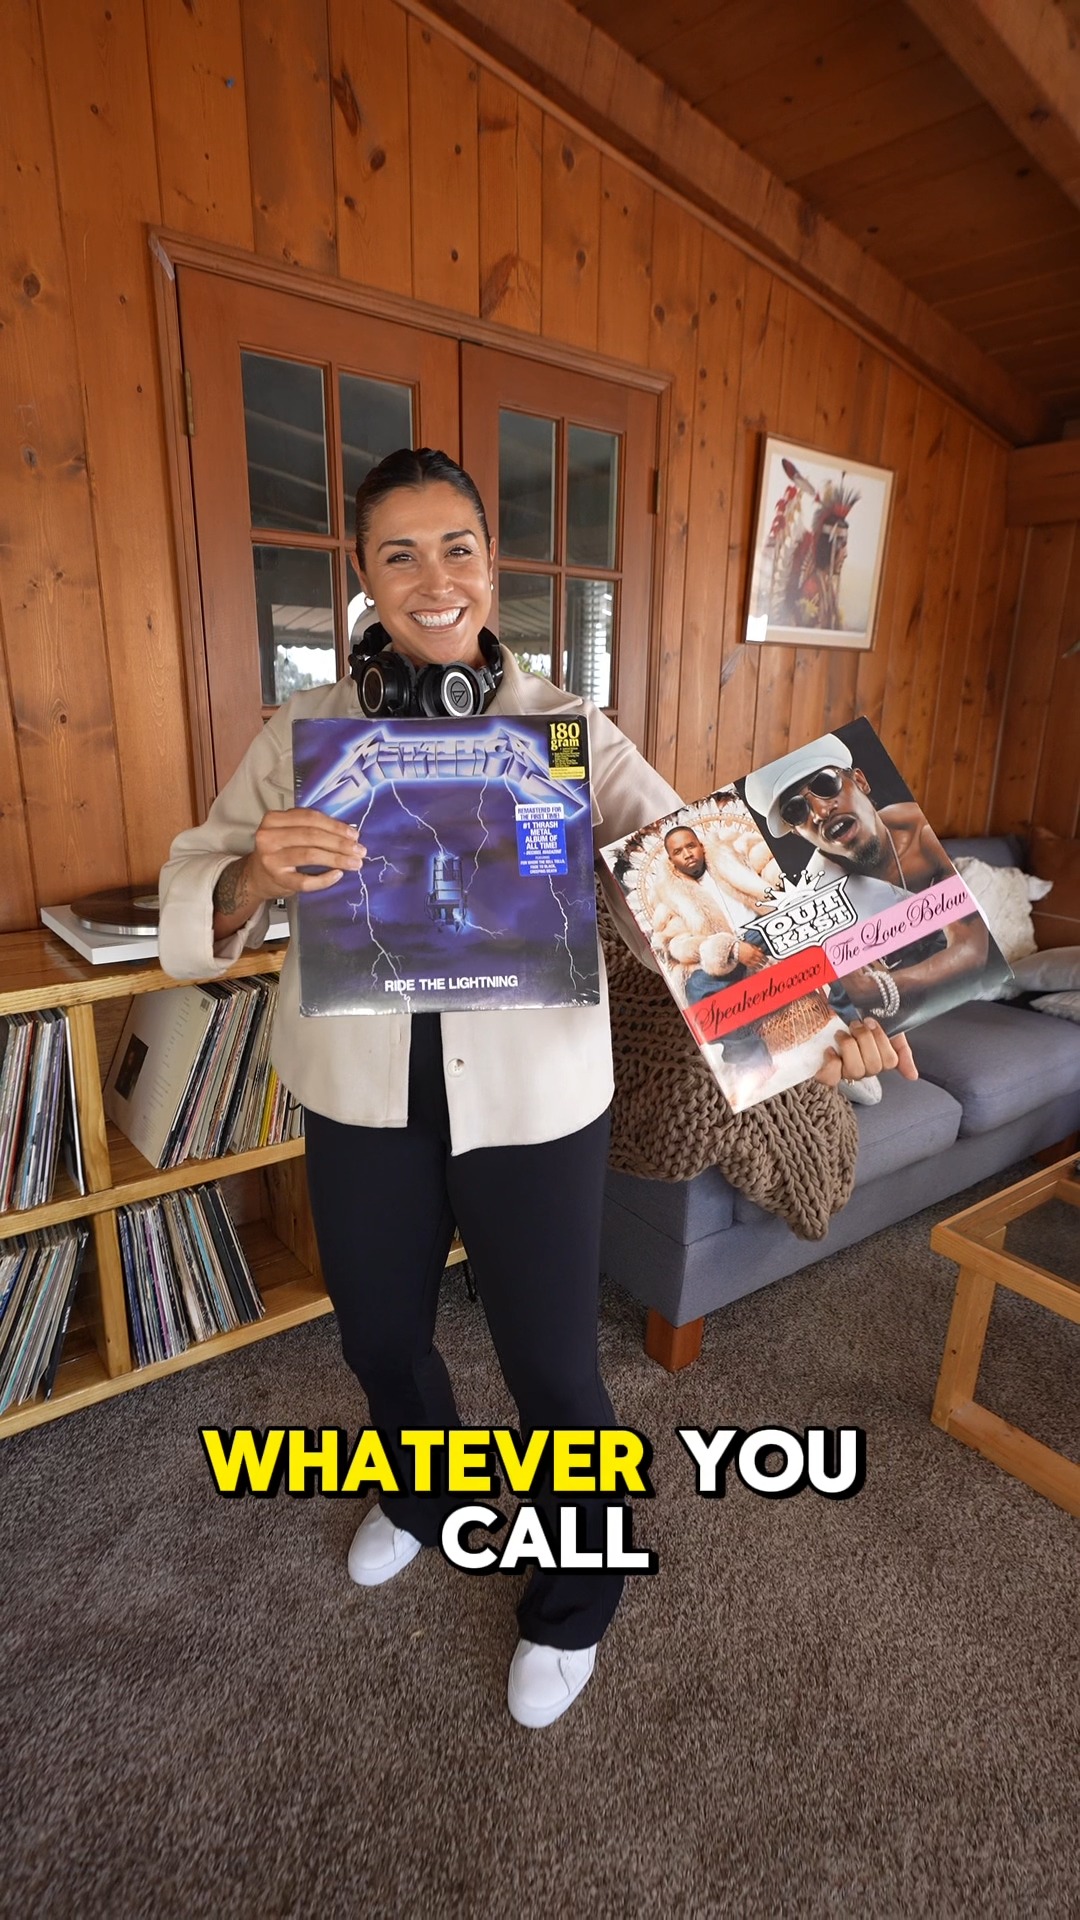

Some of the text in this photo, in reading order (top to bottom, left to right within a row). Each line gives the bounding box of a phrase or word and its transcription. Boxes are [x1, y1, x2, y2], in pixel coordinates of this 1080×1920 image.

[549, 722, 580, 739] 180
[550, 738, 580, 751] gram
[301, 727, 588, 818] METALLICA
[532, 821, 559, 829] THRASH
[525, 834, 558, 843] ALBUM OF
[526, 842, 539, 850] ALL
[765, 889, 841, 936] OUT
[770, 909, 850, 950] KAST
[695, 964, 821, 1034] Speakerboxxx
[829, 937, 861, 966] The
[860, 918, 907, 952] Love
[906, 890, 969, 928] Below
[384, 975, 519, 992] RIDE THE LIGHTNING
